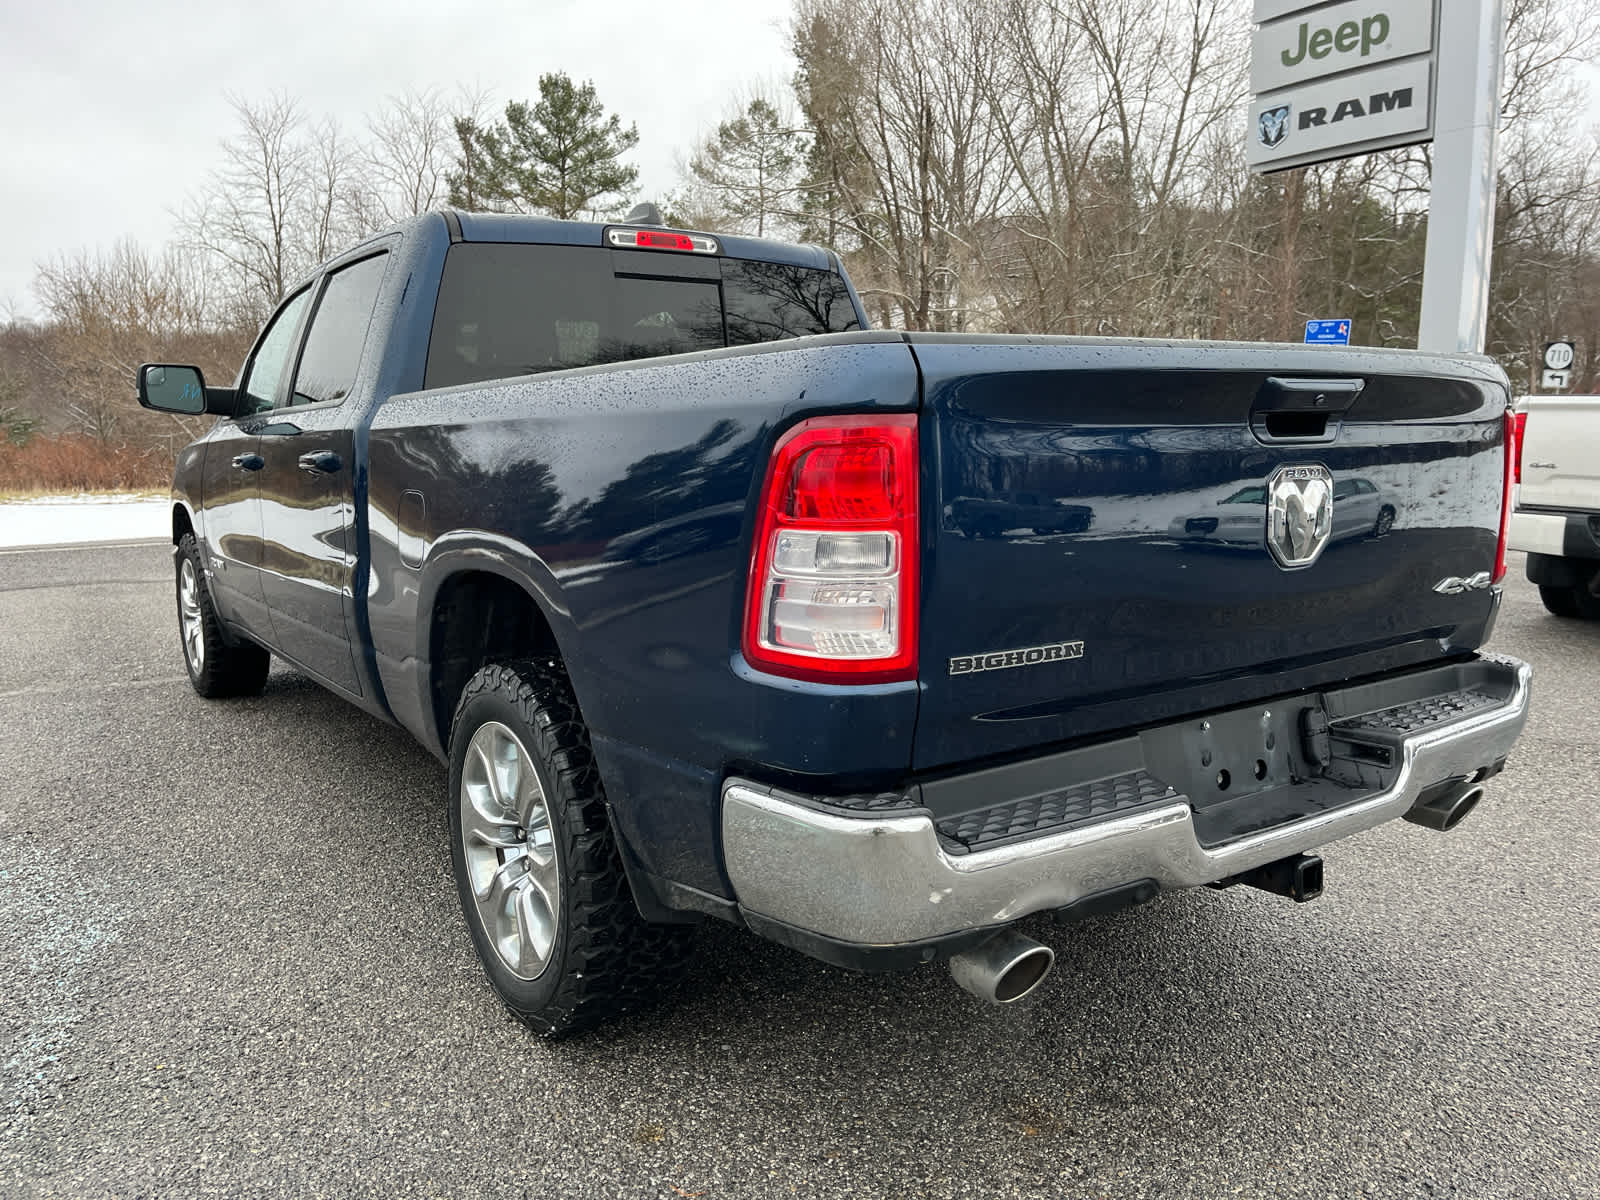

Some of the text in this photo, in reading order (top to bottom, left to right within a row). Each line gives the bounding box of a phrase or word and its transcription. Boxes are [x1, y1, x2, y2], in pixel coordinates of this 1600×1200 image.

[1281, 13, 1390, 67] Jeep
[1298, 87, 1413, 130] RAM
[1551, 350, 1570, 361] 710
[1285, 468, 1321, 478] RAM
[949, 641, 1084, 675] BIGHORN
